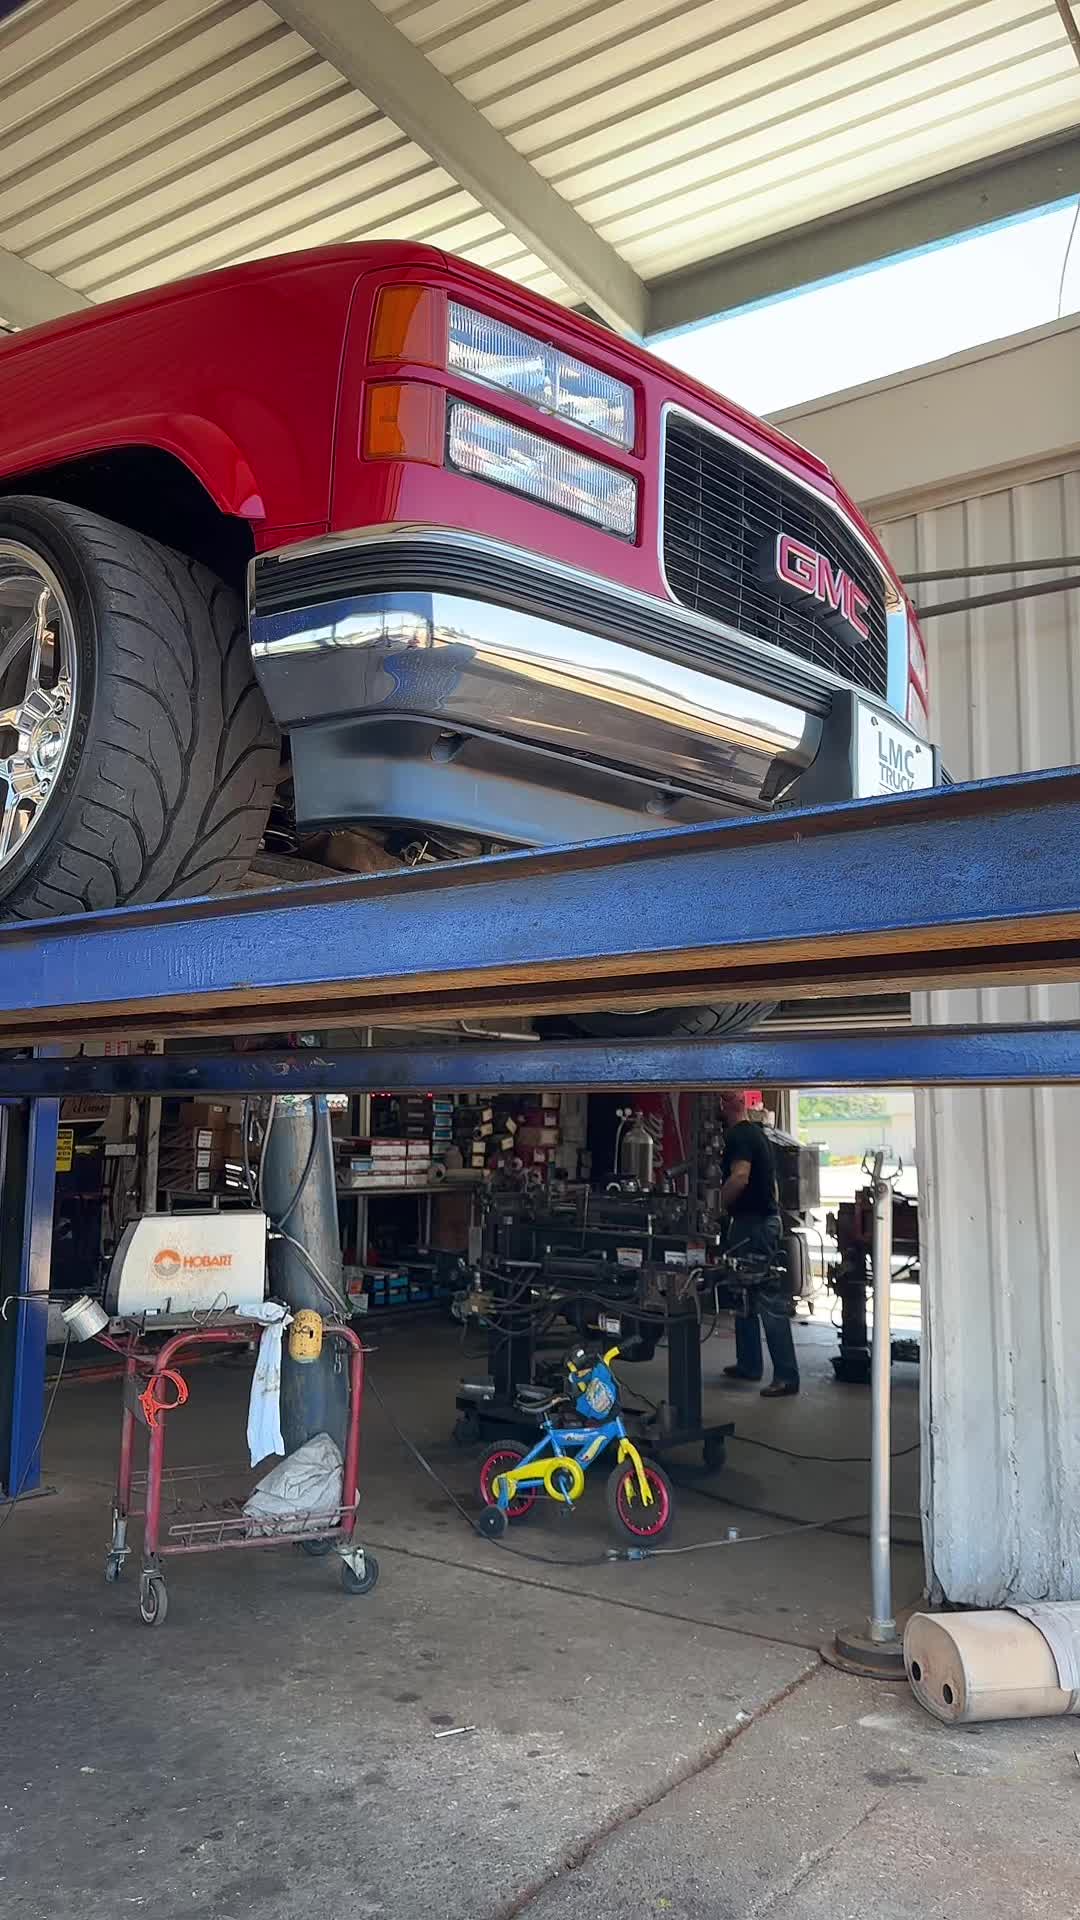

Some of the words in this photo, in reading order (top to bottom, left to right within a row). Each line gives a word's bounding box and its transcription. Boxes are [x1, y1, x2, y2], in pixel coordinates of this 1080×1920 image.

[777, 532, 871, 639] GMC
[878, 731, 914, 779] LMC
[183, 1254, 232, 1268] HOBART
